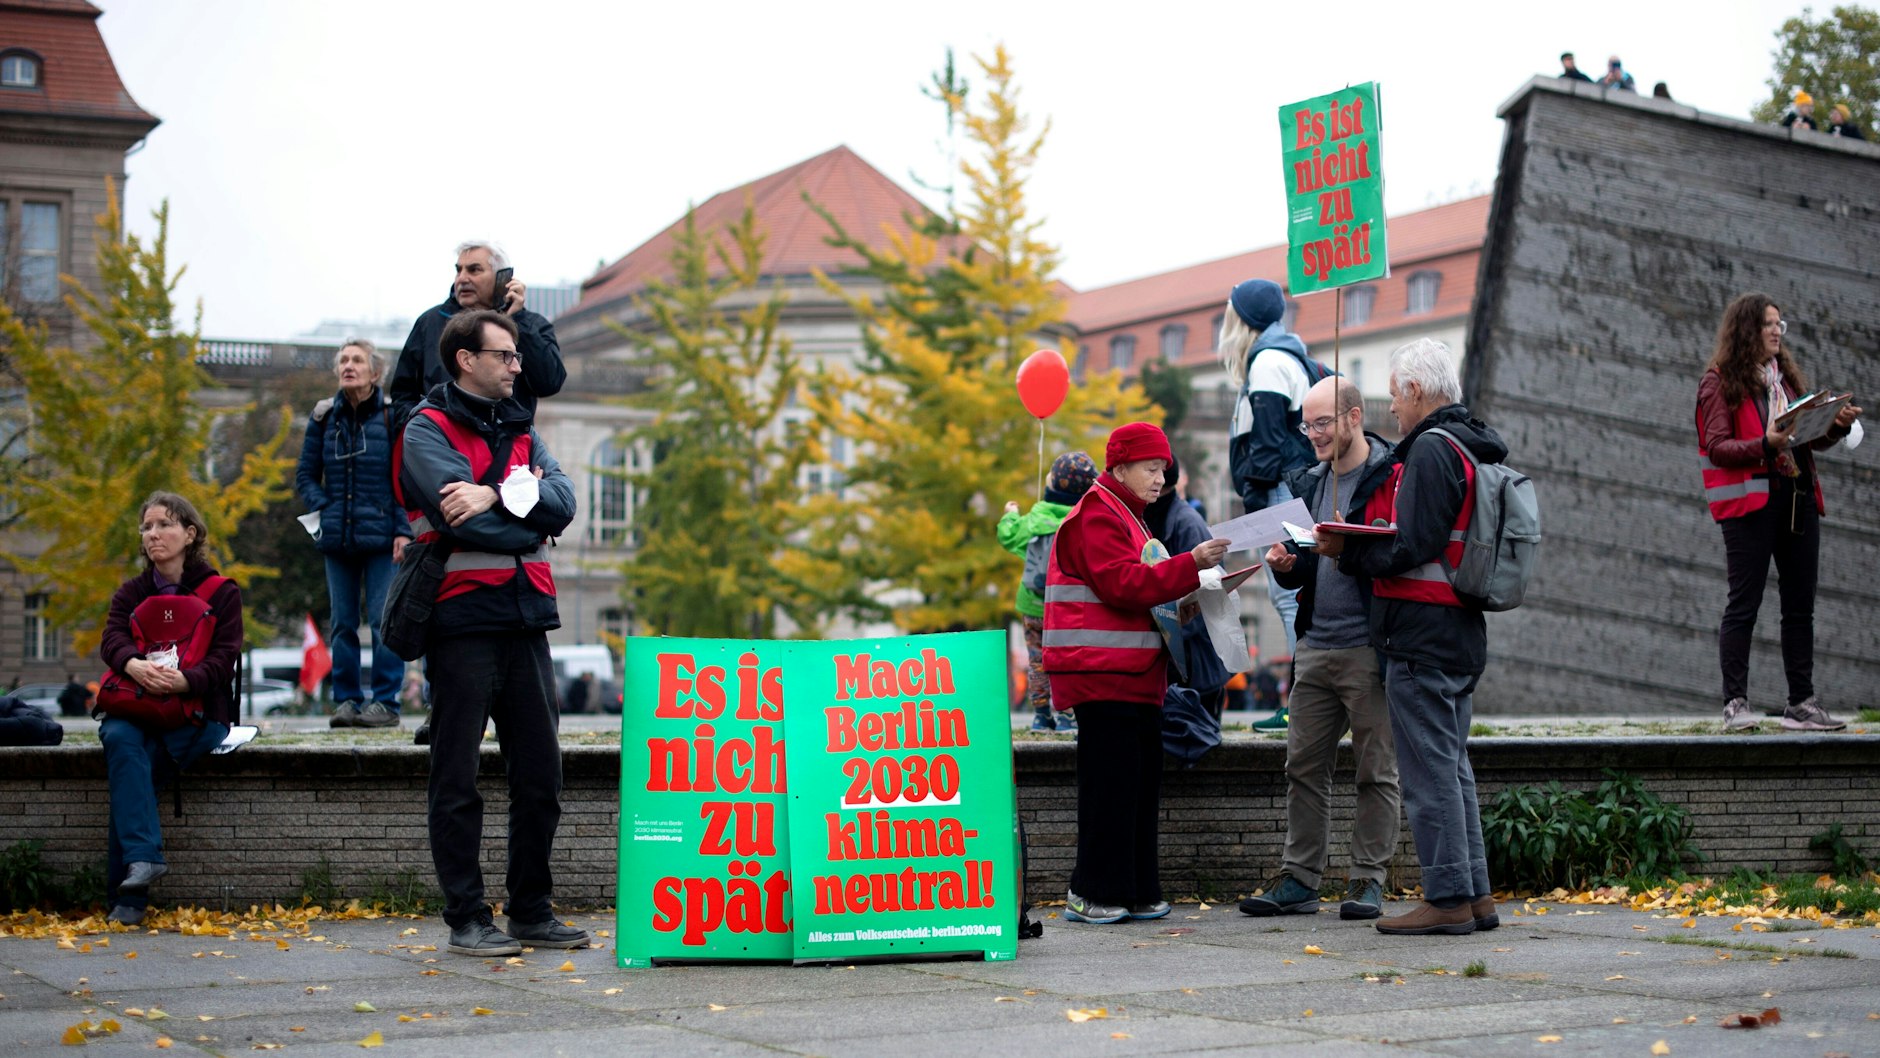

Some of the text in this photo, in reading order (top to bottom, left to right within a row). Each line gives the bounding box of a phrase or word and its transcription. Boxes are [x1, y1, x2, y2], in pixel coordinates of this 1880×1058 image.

[1294, 96, 1364, 151] Es ist
[1293, 139, 1372, 195] nicht
[1317, 187, 1354, 227] zu
[1302, 222, 1371, 282] spät!
[654, 652, 727, 722] Es
[833, 648, 956, 701] Mach
[823, 699, 971, 753] Berlin
[842, 753, 960, 806] 2030
[698, 801, 777, 857] zu
[825, 809, 978, 862] klima-
[651, 859, 794, 946] spät
[813, 861, 995, 914] neutral!
[808, 924, 1002, 942] Alles zum Volksentscheid: berlin2030.org
